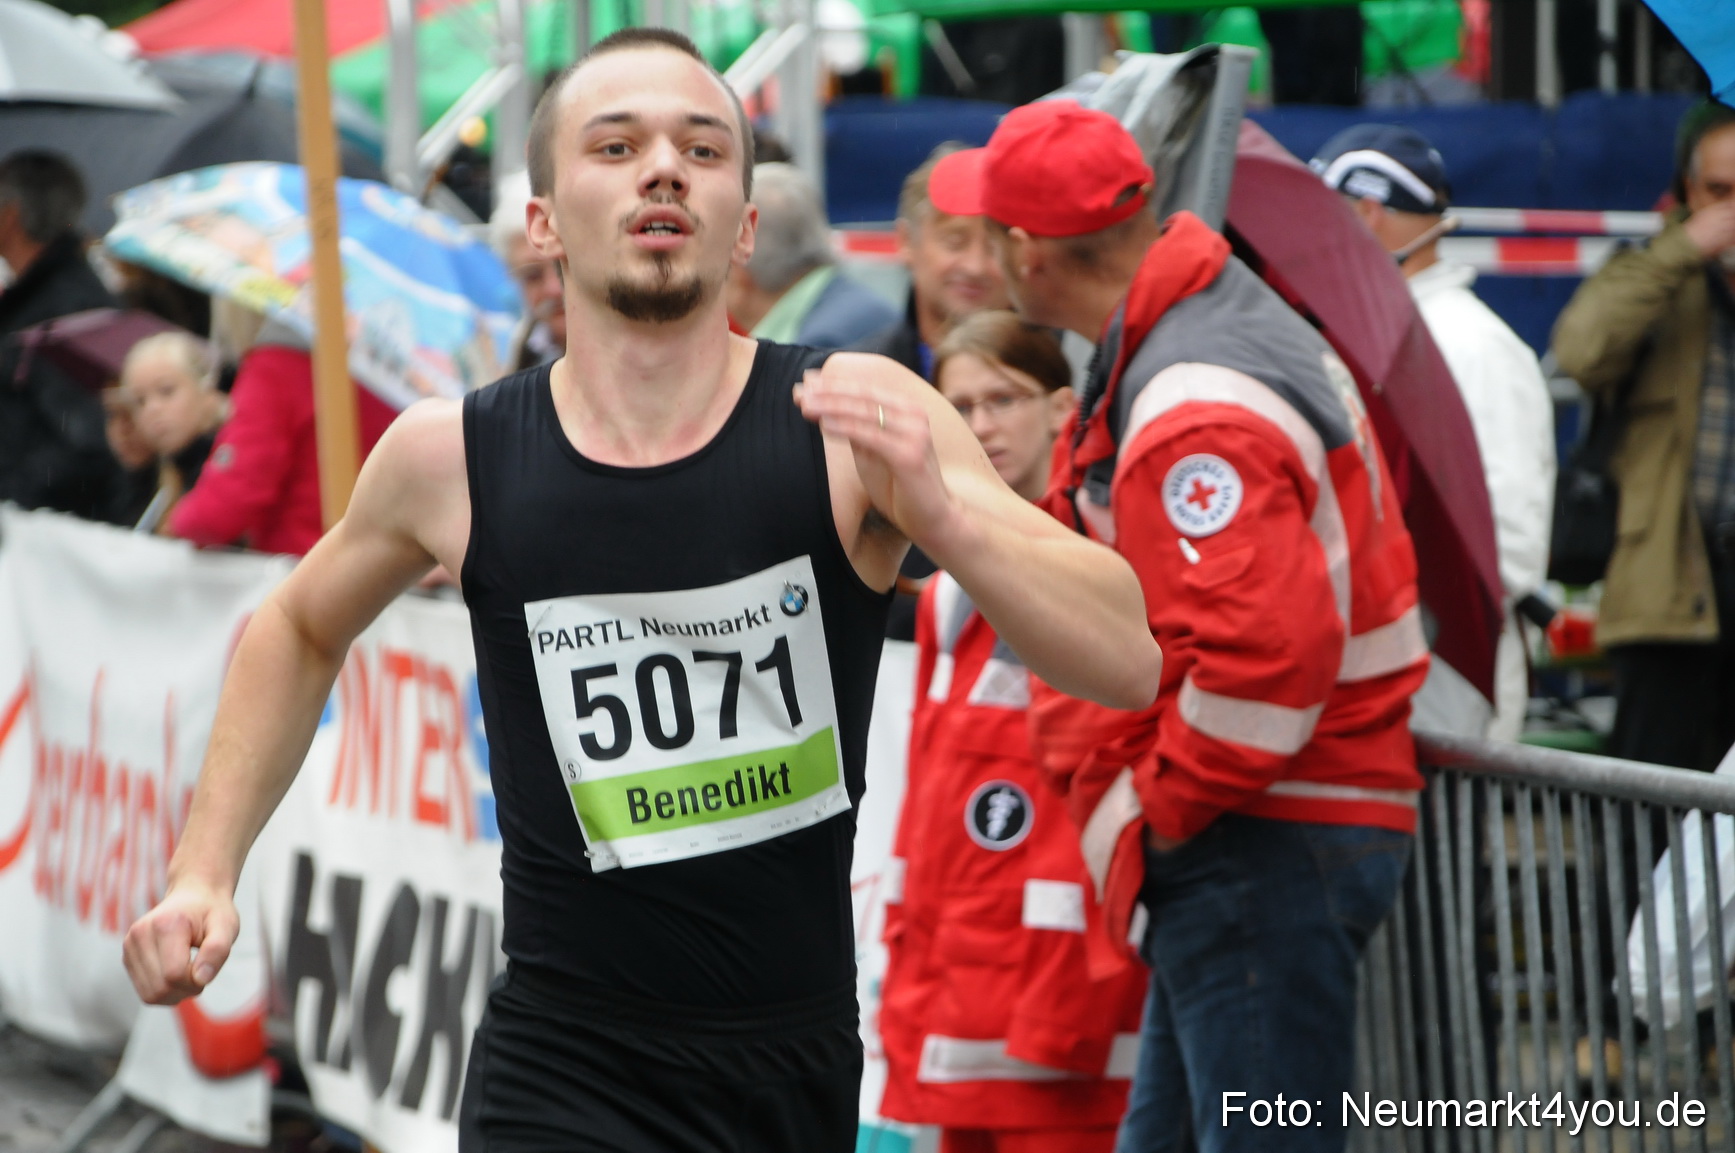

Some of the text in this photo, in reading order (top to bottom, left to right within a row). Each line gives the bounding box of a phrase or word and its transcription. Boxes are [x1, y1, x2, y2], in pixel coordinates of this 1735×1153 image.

[538, 603, 773, 655] PARTL Neumarkt
[569, 633, 805, 762] 5071
[626, 761, 793, 826] Benedikt
